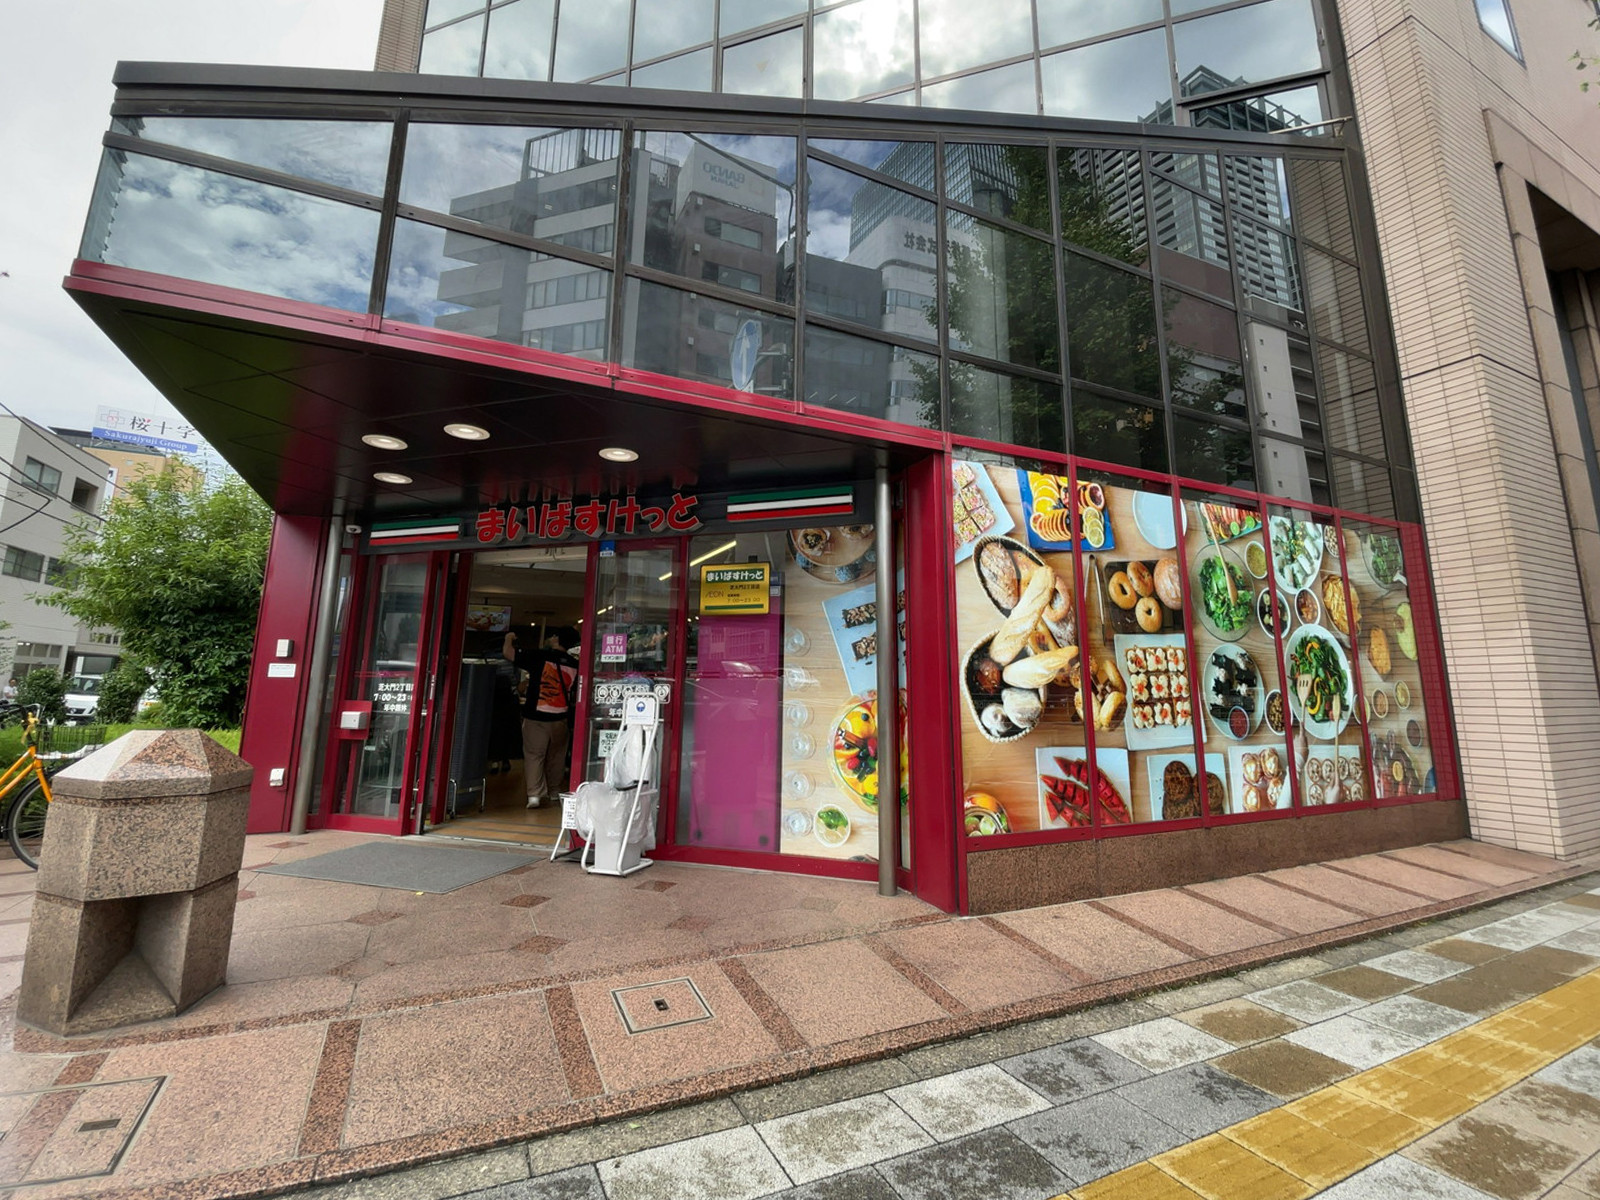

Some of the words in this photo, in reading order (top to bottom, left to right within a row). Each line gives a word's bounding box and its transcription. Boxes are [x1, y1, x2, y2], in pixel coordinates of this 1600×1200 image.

[130, 416, 195, 438] 桜十字
[104, 429, 158, 446] Sakurajyuji
[159, 440, 188, 451] Group
[476, 493, 702, 542] まいばすけっと
[706, 571, 763, 581] まいばすけっと
[605, 645, 624, 654] ATM
